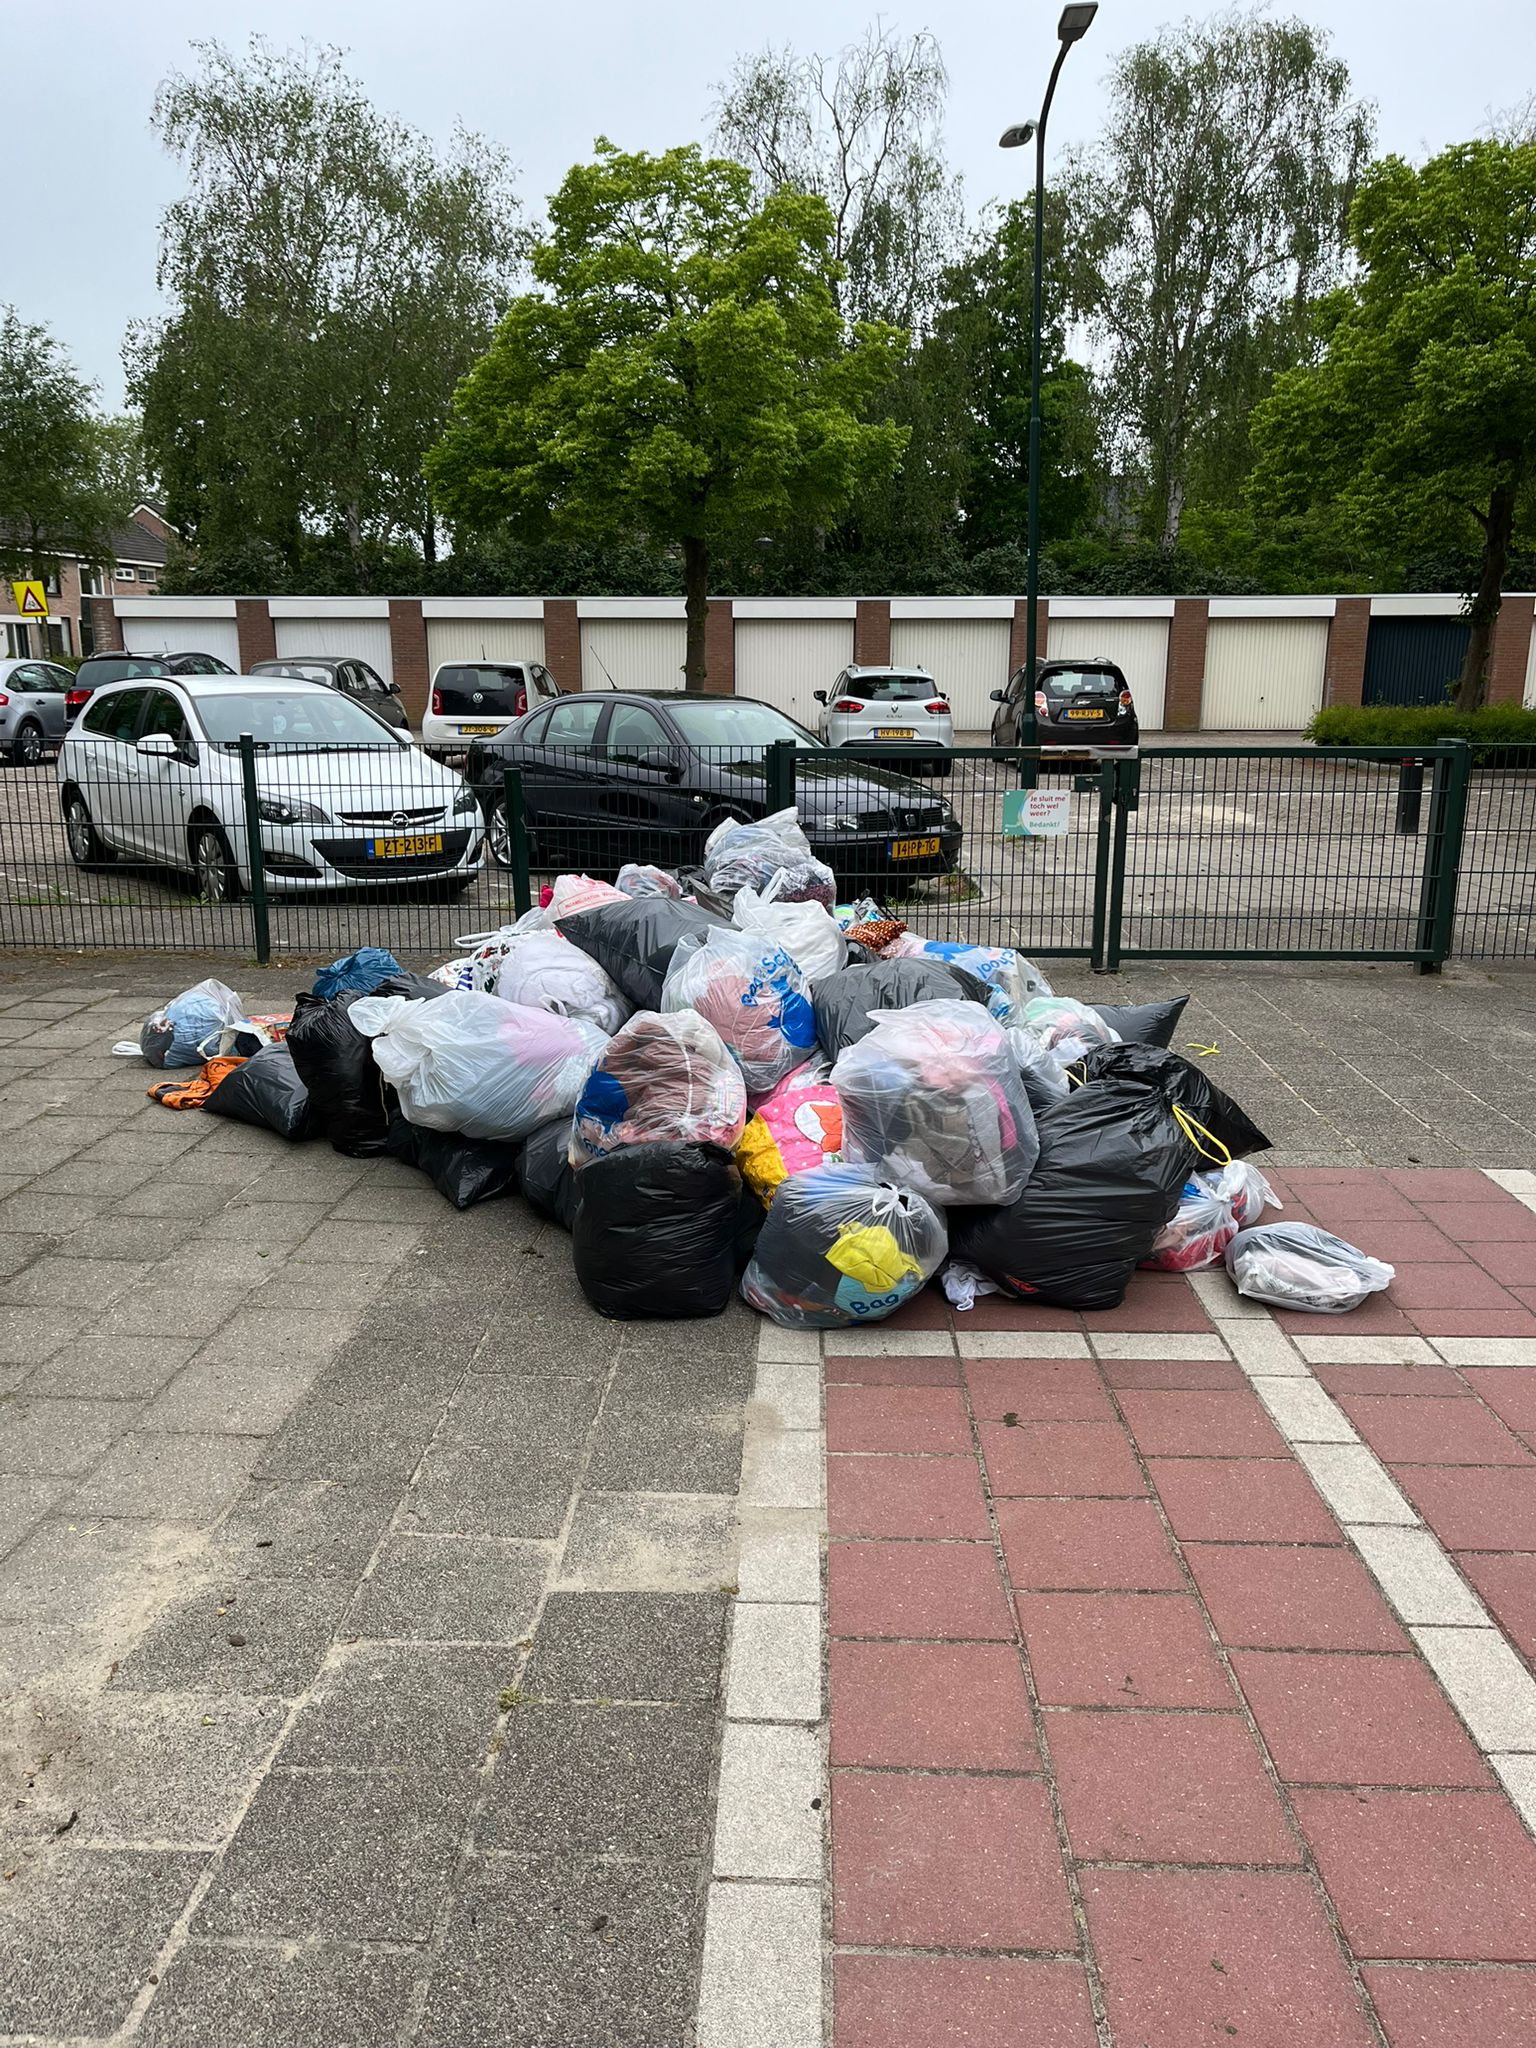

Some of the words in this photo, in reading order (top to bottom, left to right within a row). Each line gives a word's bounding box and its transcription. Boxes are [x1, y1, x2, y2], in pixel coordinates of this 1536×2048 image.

[384, 837, 436, 854] ZT-213-F
[897, 839, 936, 856] 14-PP-TG
[850, 1294, 899, 1315] Bag
